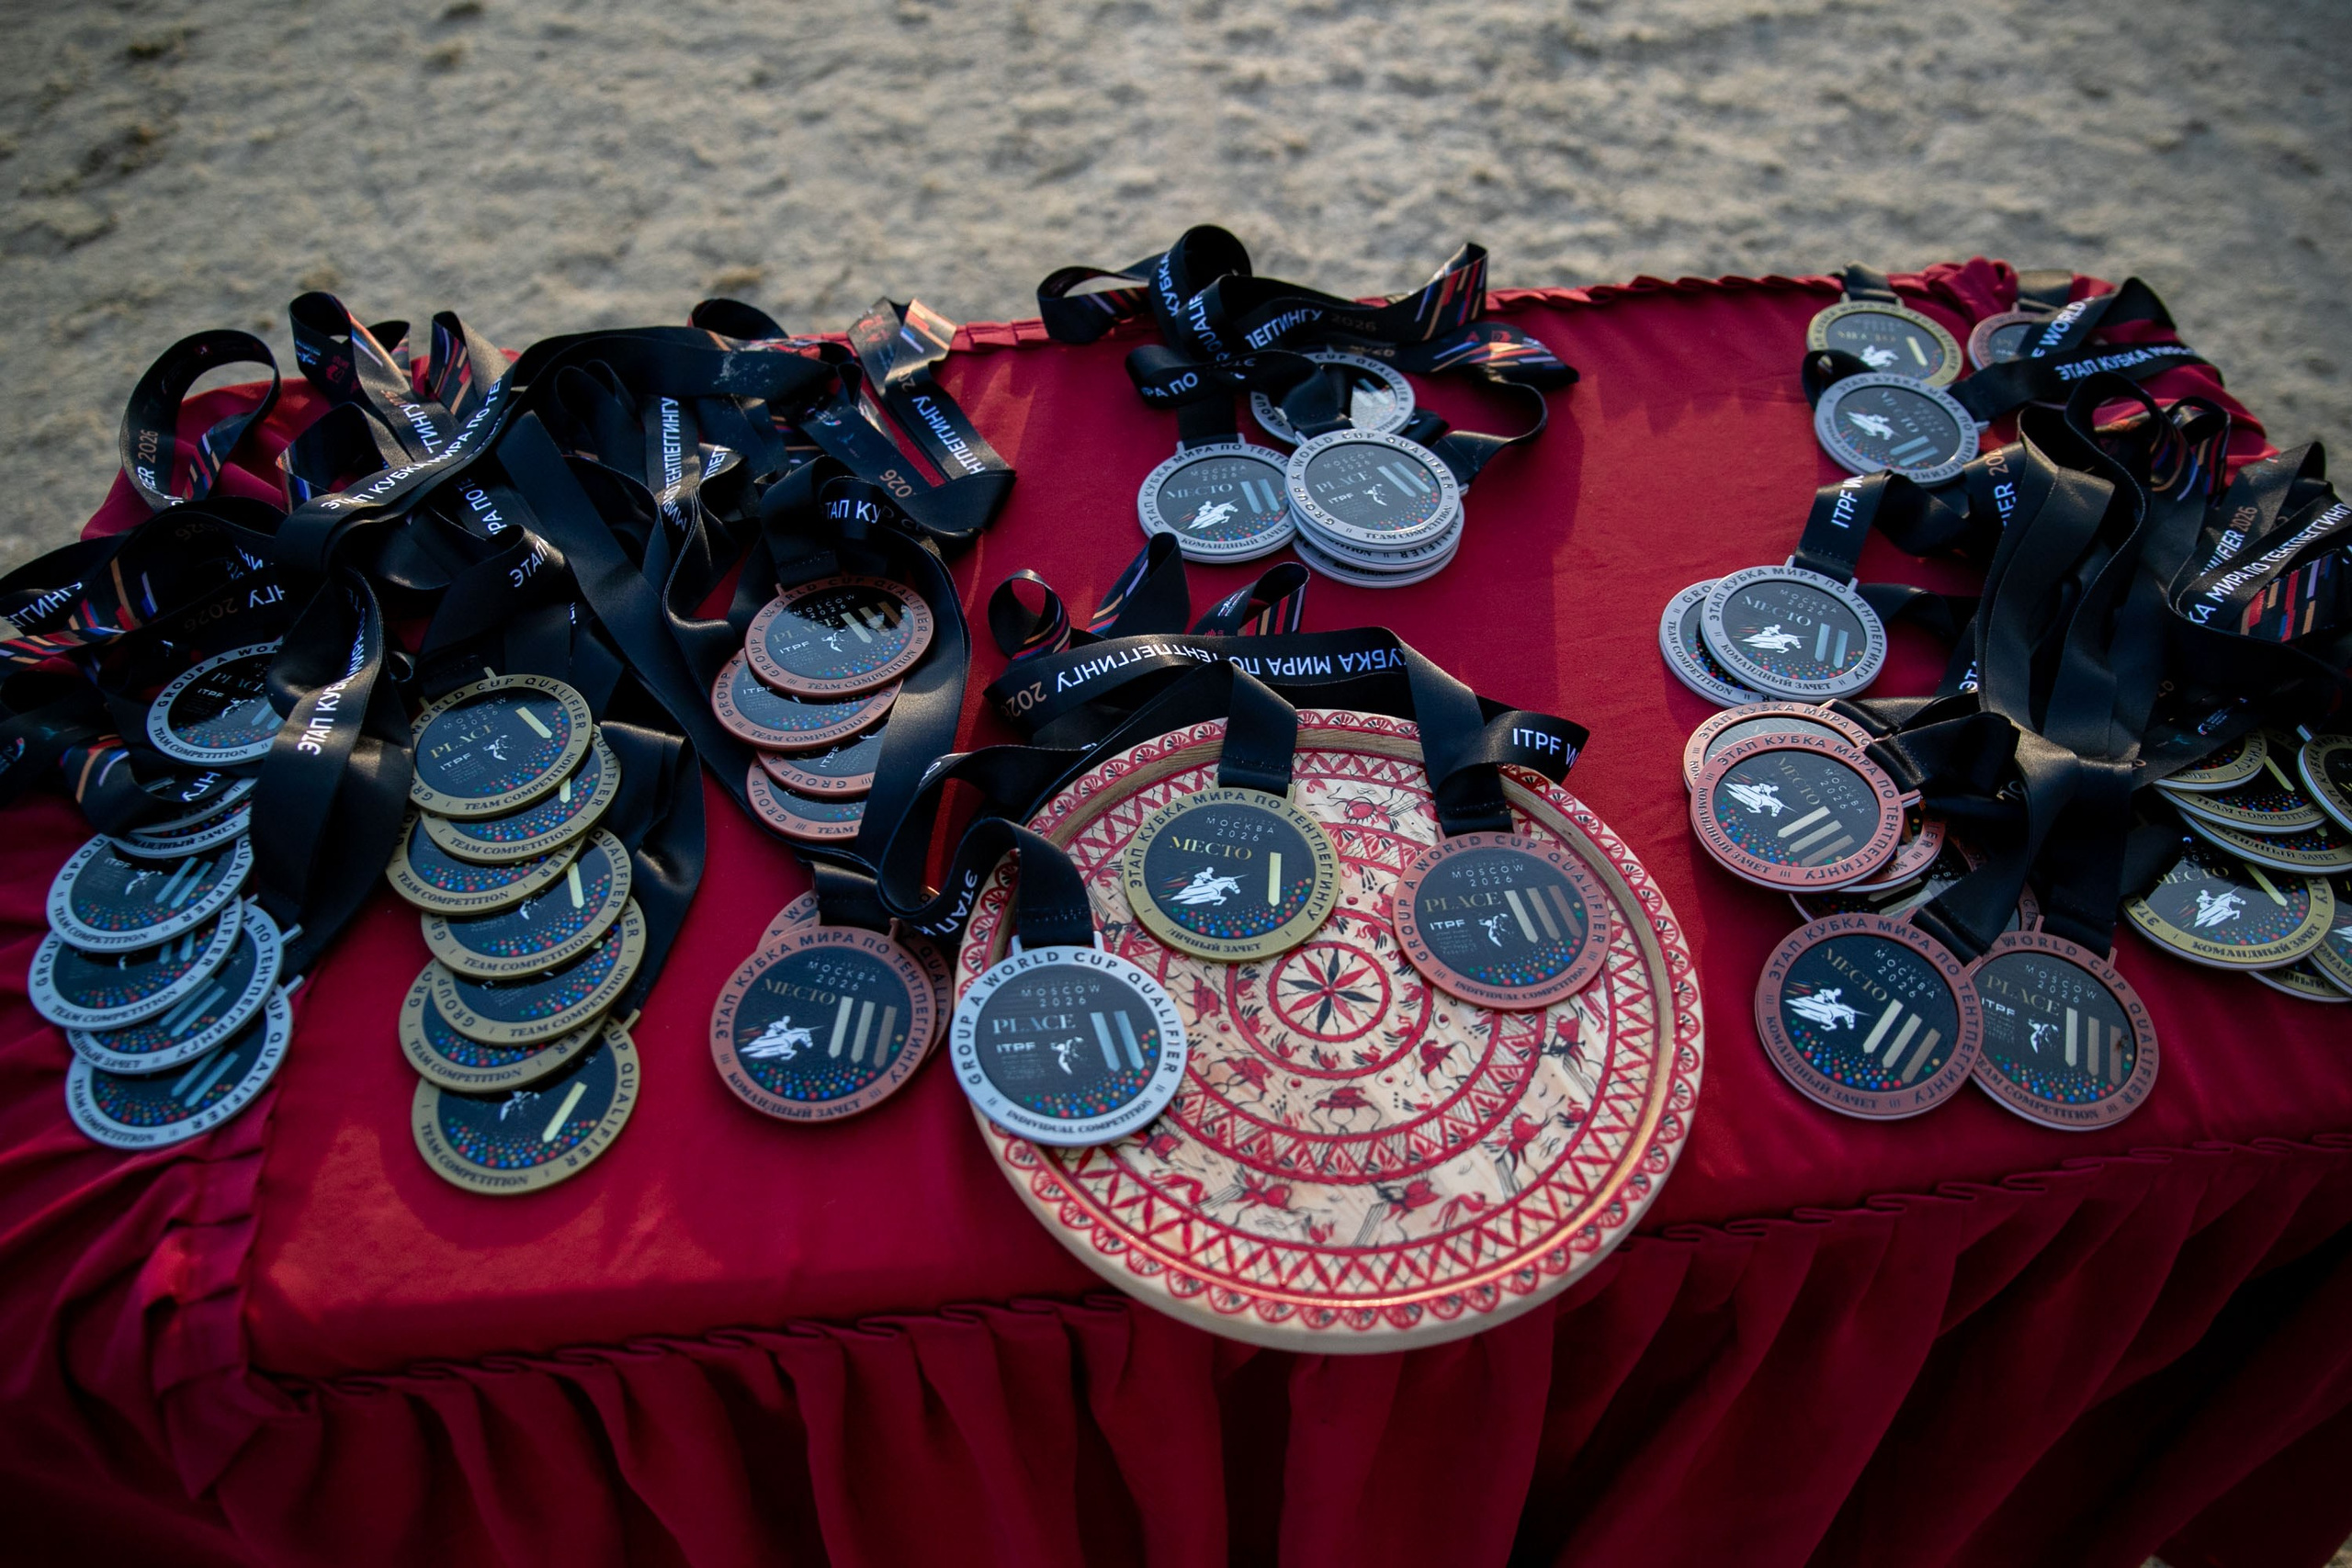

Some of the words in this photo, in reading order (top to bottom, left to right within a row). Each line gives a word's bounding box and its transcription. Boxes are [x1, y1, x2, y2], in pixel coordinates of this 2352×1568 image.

[1168, 371, 1199, 395] ПО
[1355, 357, 1408, 402] QUALIFIER
[2053, 359, 2099, 381] ЭТАП
[138, 429, 158, 463] 2026
[321, 493, 374, 510] ЭТАП
[368, 462, 426, 494] КУБКА
[466, 407, 490, 430] ПО
[661, 396, 683, 489] ТЕНТПЕГГИНГУ
[1173, 446, 1214, 464] МИРА
[1293, 436, 1333, 468] WORLD
[1385, 436, 1453, 490] QUALIFIER
[1145, 465, 1171, 497] КУБКА
[1328, 492, 1355, 504] ITPF
[1145, 502, 1163, 526] ЭТАП
[1294, 487, 1335, 525] GROUP
[1399, 505, 1452, 539] COMPETITION
[1830, 490, 1859, 529] ITPF
[828, 576, 865, 586] CUP
[762, 583, 818, 618] WORLD
[793, 593, 855, 616] MOSCOW
[874, 580, 930, 633] QUALIFIER
[1742, 596, 1812, 626] МЕСТО
[755, 625, 764, 633] A
[1709, 592, 1725, 622] ЭТАП
[1724, 569, 1767, 592] КУБКА
[1771, 568, 1818, 581] МИРА
[1825, 579, 1848, 594] ПО
[1849, 595, 1883, 681] ТЕНТПЕГГИНГУ
[750, 637, 780, 678] GROUP
[779, 640, 810, 655] ITPF
[843, 649, 917, 689] COMPETITION
[1057, 643, 1218, 693] ТЕНТПЕГГИНГУ
[1228, 656, 1261, 676] ПО
[1265, 655, 1332, 677] МИРА
[1672, 645, 1734, 696] COMPETITION
[1721, 643, 1792, 687] КОМАНДНЫЙ
[158, 666, 205, 707] GROUP
[197, 688, 225, 698] ITPF
[526, 678, 587, 729] QUALIFIER
[718, 672, 734, 716] GROUP
[297, 717, 334, 756] ЭТАП
[786, 714, 870, 743] COMPETITION
[1698, 714, 1734, 739] ЭТАП
[1736, 704, 1796, 717] КУБКА
[1804, 706, 1849, 729] МИРА
[169, 742, 248, 759] COMPETITION
[1512, 728, 1562, 756] ITPF
[1717, 740, 1758, 766] ЭТАП
[1764, 735, 1826, 749] КУБКА
[439, 752, 472, 771] ITPF
[1834, 745, 1878, 777] МИРА
[464, 801, 501, 811] TEAM
[503, 751, 576, 804] COMPETITION
[781, 769, 847, 789] GROUP
[1775, 757, 1822, 807] МЕСТО
[1819, 779, 1848, 811] 2026
[1823, 768, 1865, 815] МОСКВА
[1878, 779, 1895, 799] ПО
[752, 781, 788, 822] GROUP
[2197, 796, 2233, 814] TEAM
[1205, 817, 1274, 834] МОСКВА
[1216, 829, 1261, 842] 2026
[1698, 787, 1732, 859] КОМАНДНЫЙ
[449, 836, 481, 854] TEAM
[482, 826, 573, 855] COMPETITION
[1130, 848, 1145, 888] ЭТАП
[1139, 802, 1187, 842] КУБКА
[1193, 791, 1246, 805] МИРА
[1253, 795, 1282, 810] ПО
[1286, 808, 1333, 921] ТЕНТПЕГГИНГУ
[1169, 836, 1253, 862] МЕСТО
[1804, 805, 1900, 880] ТЕНТПЕГГИНГУ
[182, 839, 251, 922] QUALIFIER
[592, 829, 628, 908] QUALIFIER
[1452, 863, 1524, 879] MOSCOW
[1470, 875, 1513, 887] 2026
[397, 871, 421, 897] TEAM
[421, 890, 510, 906] COMPETITION
[935, 869, 978, 933] ЭТАП
[1398, 898, 1429, 963] GROUP
[1414, 836, 1482, 872] WORLD
[1494, 835, 1538, 851] CUP
[1547, 852, 1607, 944] QUALIFIER
[1425, 891, 1502, 914] PLACE
[1165, 928, 1221, 952] ЛИЧНЫЙ
[1223, 942, 1262, 953] ЗАЧЕТ
[1429, 919, 1466, 931] ITPF
[1804, 918, 1868, 941] КУБКА
[1877, 920, 1931, 951] МИРА
[463, 956, 498, 971] TEAM
[501, 931, 594, 971] COMPETITION
[1769, 940, 1803, 981] ЭТАП
[1935, 952, 1960, 976] ПО
[2191, 941, 2290, 959] КОМАНДНЫЙ
[808, 960, 877, 983] МОСКВА
[815, 974, 860, 991] 2026
[1454, 980, 1519, 1001] INDIVIDUAL
[1521, 965, 1588, 1000] COMPETITION
[1821, 947, 1888, 1002] МЕСТО
[1874, 948, 1936, 999] МОСКВА
[1877, 966, 1917, 998] 2026
[2025, 964, 2098, 999] MOSCOW
[437, 977, 475, 1027] GROUP
[509, 1022, 549, 1037] TEAM
[552, 964, 630, 1029] COMPETITION
[716, 995, 738, 1039] ЭТАП
[735, 943, 792, 988] КУБКА
[799, 931, 854, 948] МИРА
[862, 937, 890, 954] ПО
[888, 953, 930, 1084] ТЕНТПЕГГИНГУ
[763, 977, 837, 1007] МЕСТО
[1021, 984, 1101, 998] MOSCOW
[1039, 997, 1086, 1008] 2026
[1982, 998, 2016, 1016] ITPF
[1985, 975, 2061, 1016] PLACE
[2038, 980, 2080, 1004] 2026
[957, 1015, 982, 1085] GROUP
[983, 952, 1059, 989] WORLD
[1074, 952, 1117, 970] CUP
[1127, 972, 1181, 1074] QUALIFIER
[992, 1014, 1076, 1034] PLACE
[2000, 935, 2078, 957] WORLD
[2088, 960, 2127, 991] CUP
[2121, 1002, 2154, 1104] QUALIFIER
[996, 1042, 1036, 1054] ITPF
[1766, 1016, 1831, 1095] КОМАНДНЫЙ
[1914, 982, 1979, 1104] ТЕНТПЕГГИНГУ
[191, 1032, 282, 1130] QUALIFIER
[431, 1058, 523, 1083] COMPETITION
[728, 1072, 812, 1119] КОМАНДНЫЙ
[2005, 1085, 2098, 1119] COMPETITION
[565, 1062, 635, 1167] QUALIFIER
[1006, 1109, 1075, 1134] INDIVIDUAL
[1079, 1098, 1153, 1134] COMPETITION
[437, 1154, 529, 1187] COMPETITION
